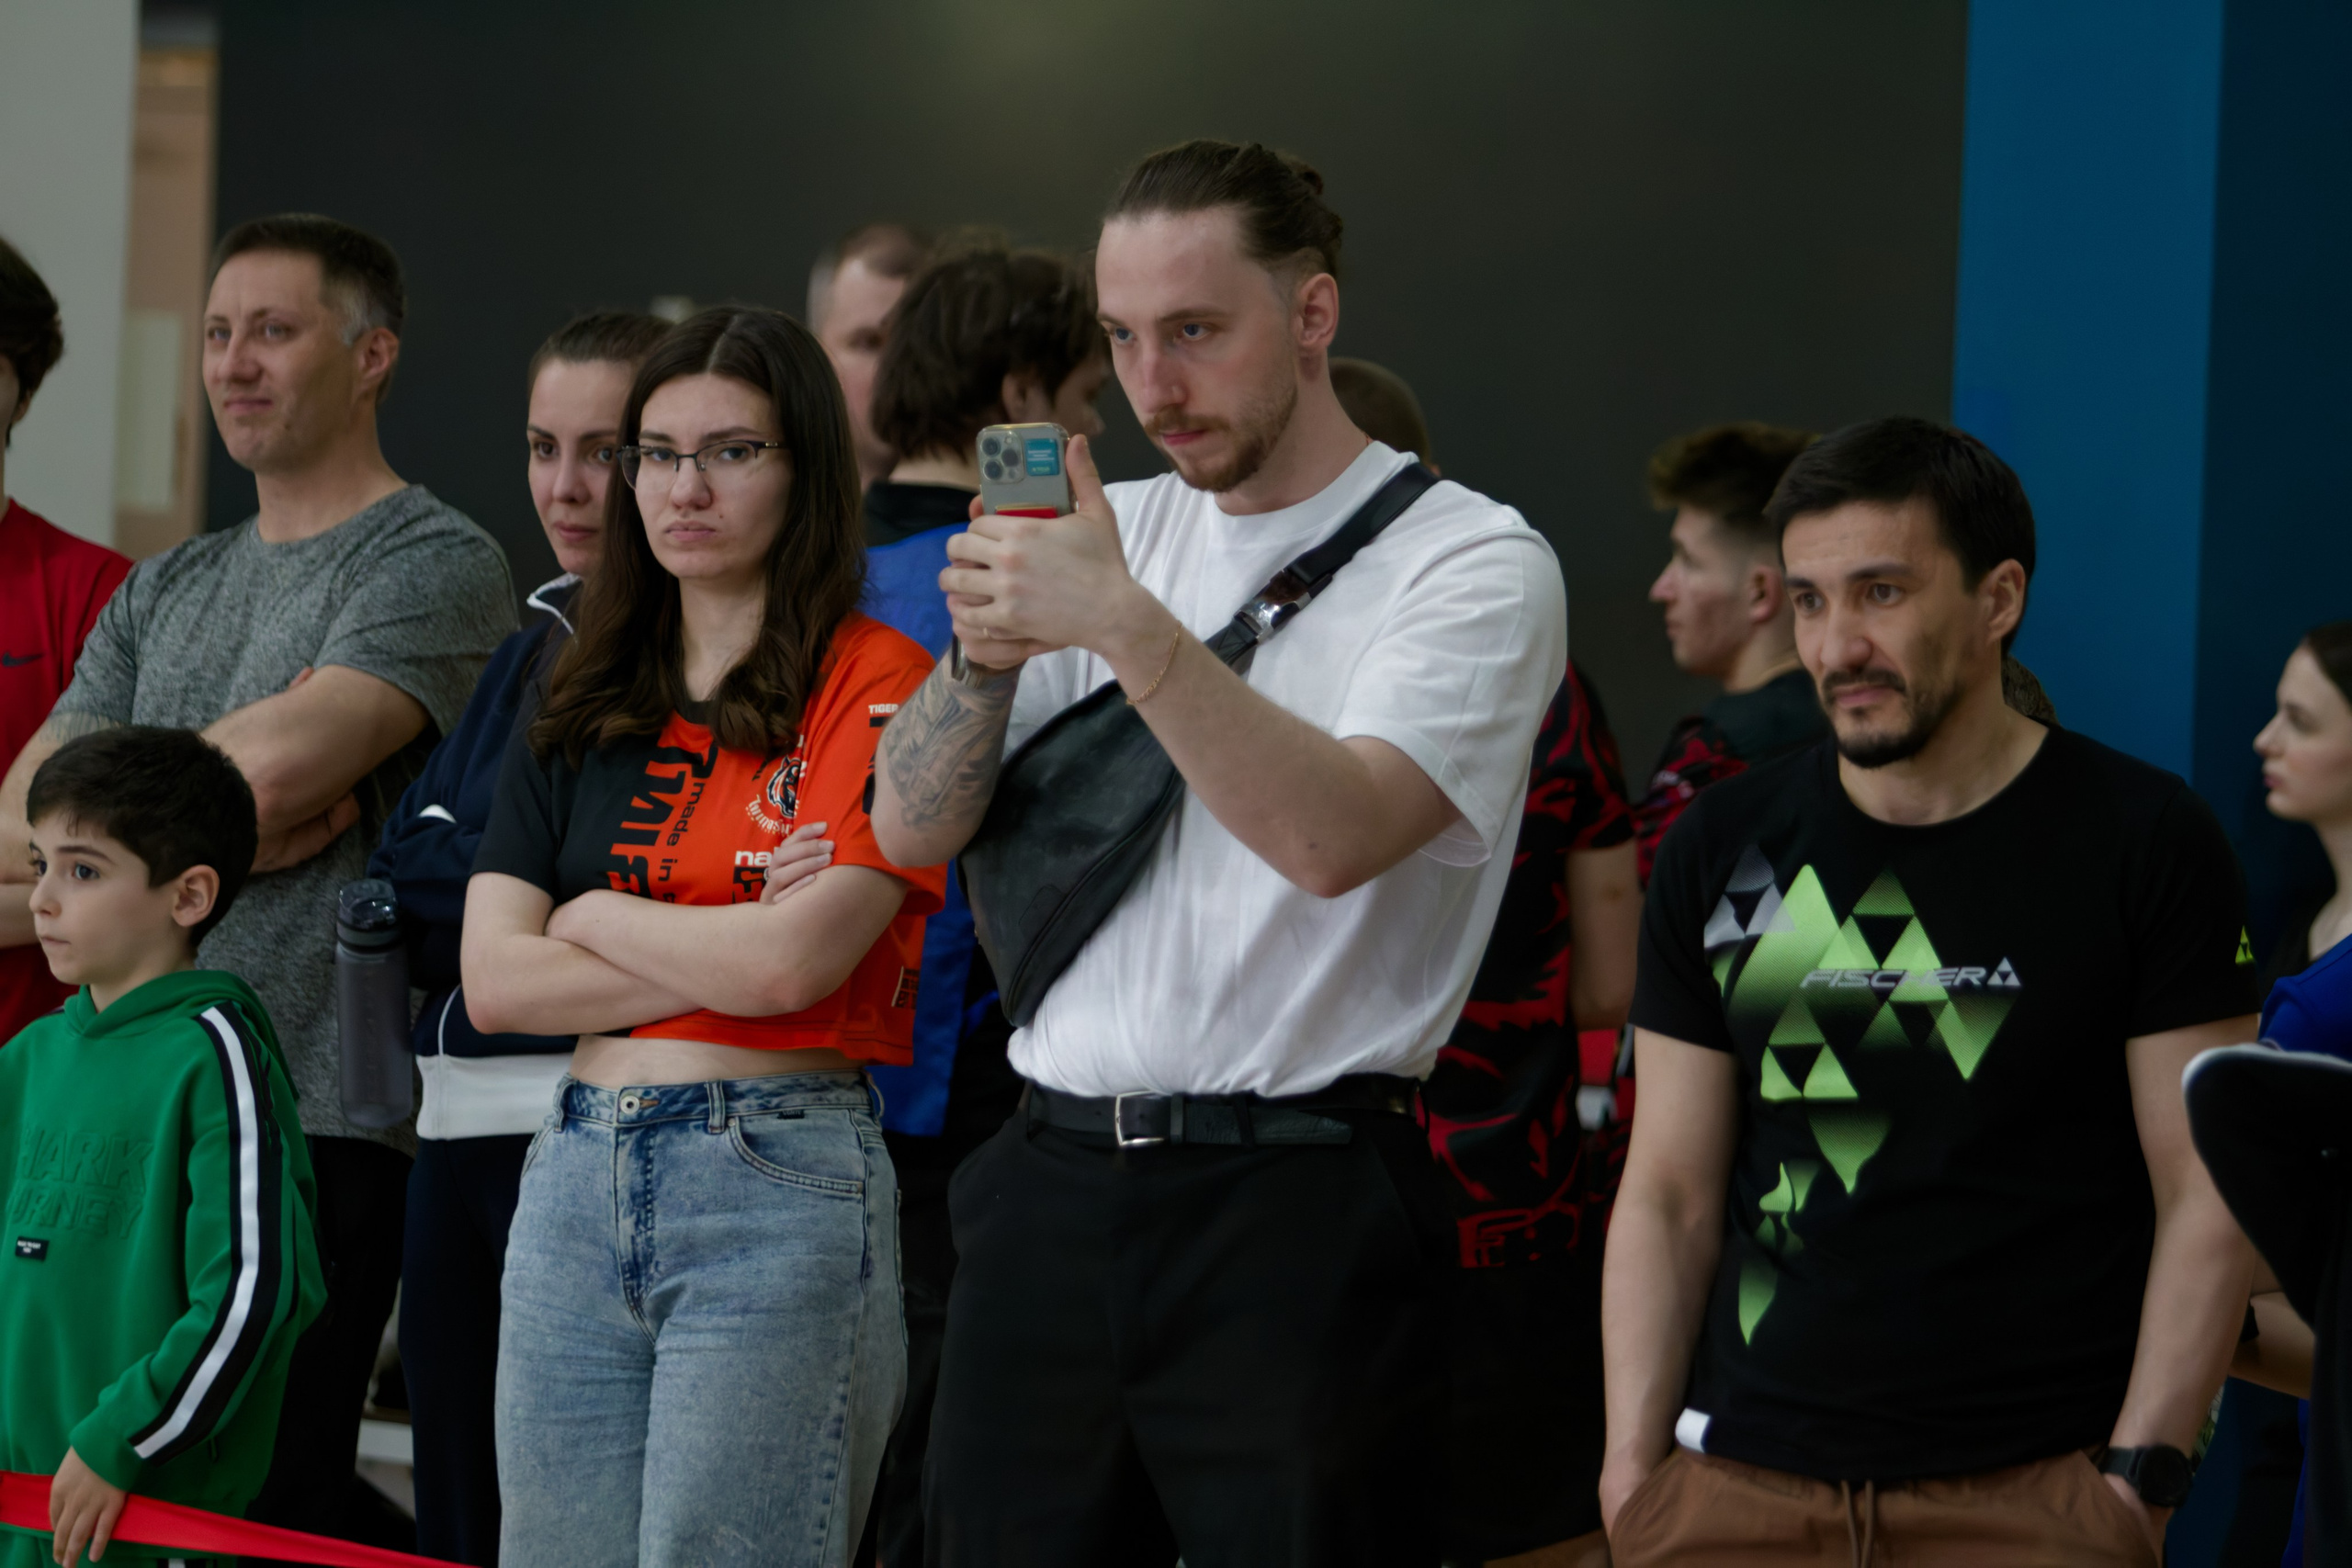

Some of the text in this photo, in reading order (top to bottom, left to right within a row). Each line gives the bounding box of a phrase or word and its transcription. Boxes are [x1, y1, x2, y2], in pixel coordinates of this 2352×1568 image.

[666, 783, 706, 847] made
[736, 847, 779, 866] na
[658, 857, 678, 882] in
[1799, 966, 1987, 989] FISCHER
